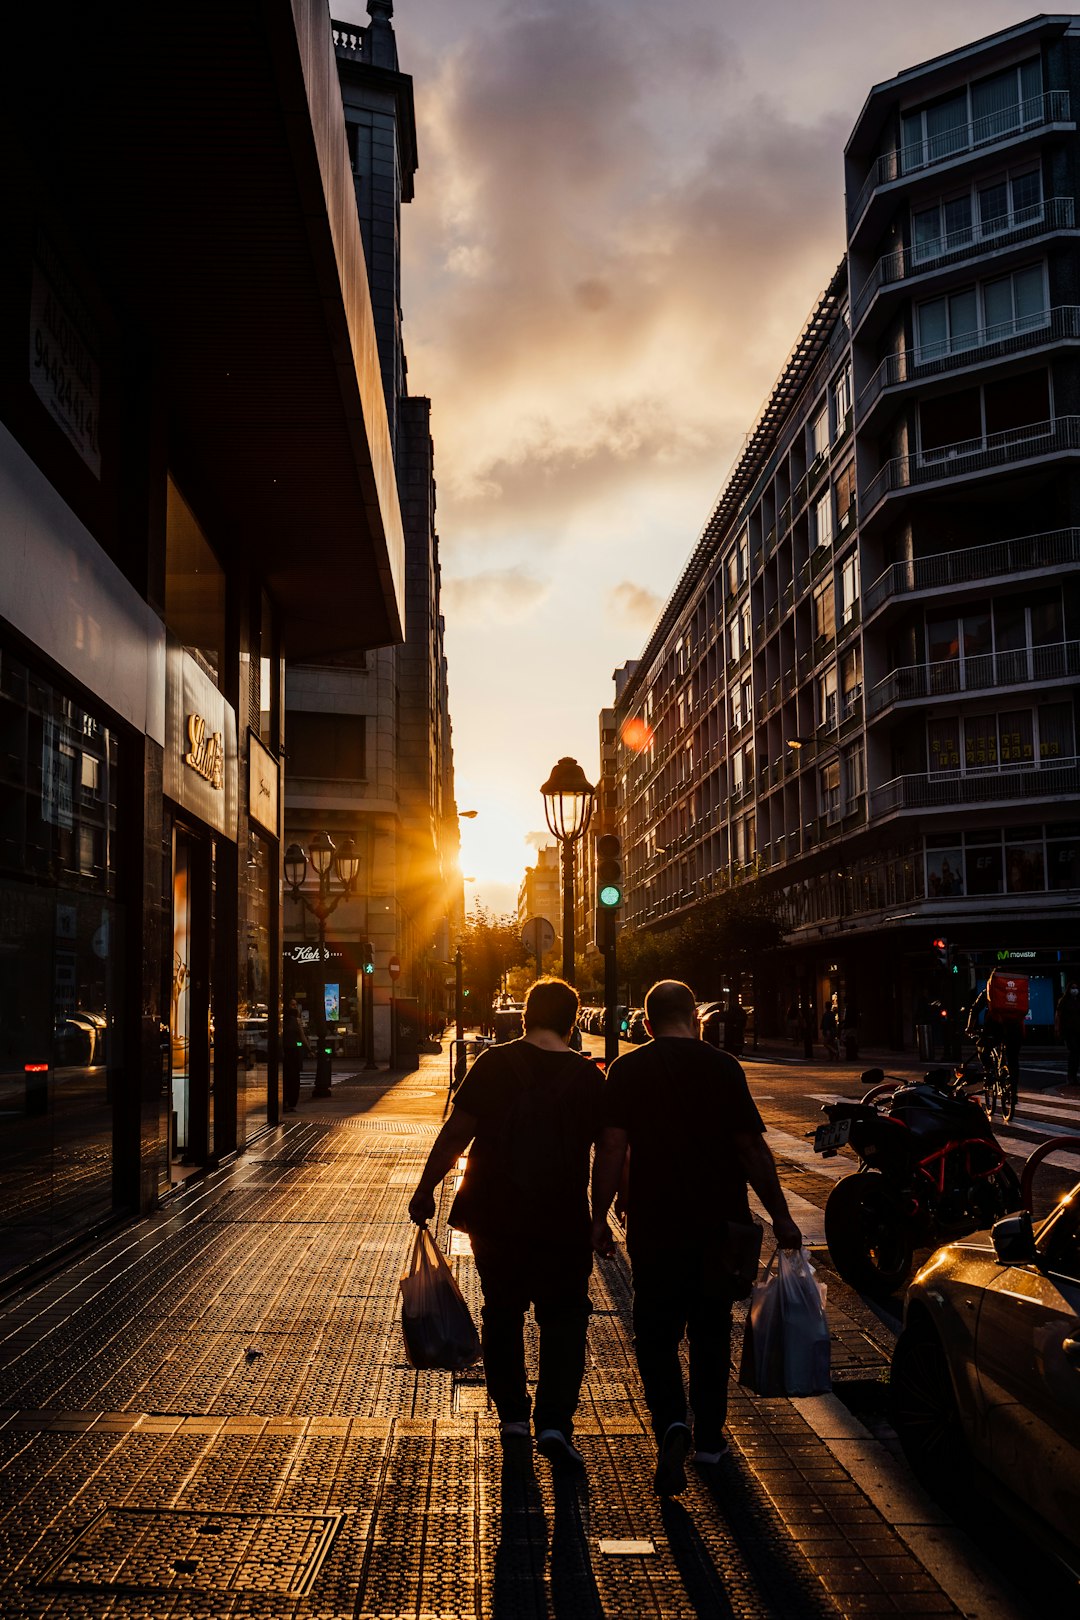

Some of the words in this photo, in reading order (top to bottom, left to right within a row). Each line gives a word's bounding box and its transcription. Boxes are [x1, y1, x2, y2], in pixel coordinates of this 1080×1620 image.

[932, 740, 954, 752] SE
[966, 732, 1020, 750] VENDE
[976, 856, 992, 869] EF
[291, 946, 329, 963] Kieh's
[1010, 951, 1036, 959] movistar
